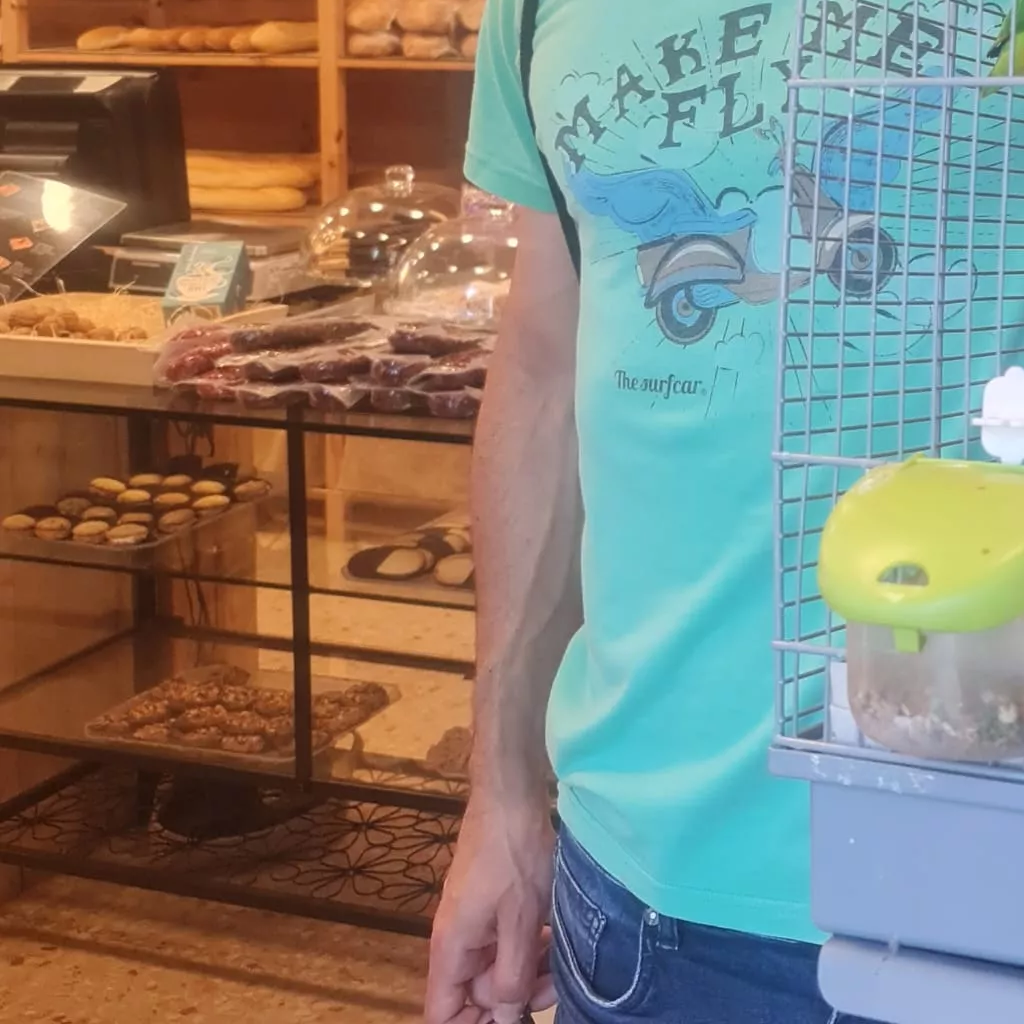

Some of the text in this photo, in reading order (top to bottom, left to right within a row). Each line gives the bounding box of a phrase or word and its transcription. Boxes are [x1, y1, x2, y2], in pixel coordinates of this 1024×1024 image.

[554, 0, 946, 174] MAKE ME
[658, 55, 813, 150] FLY
